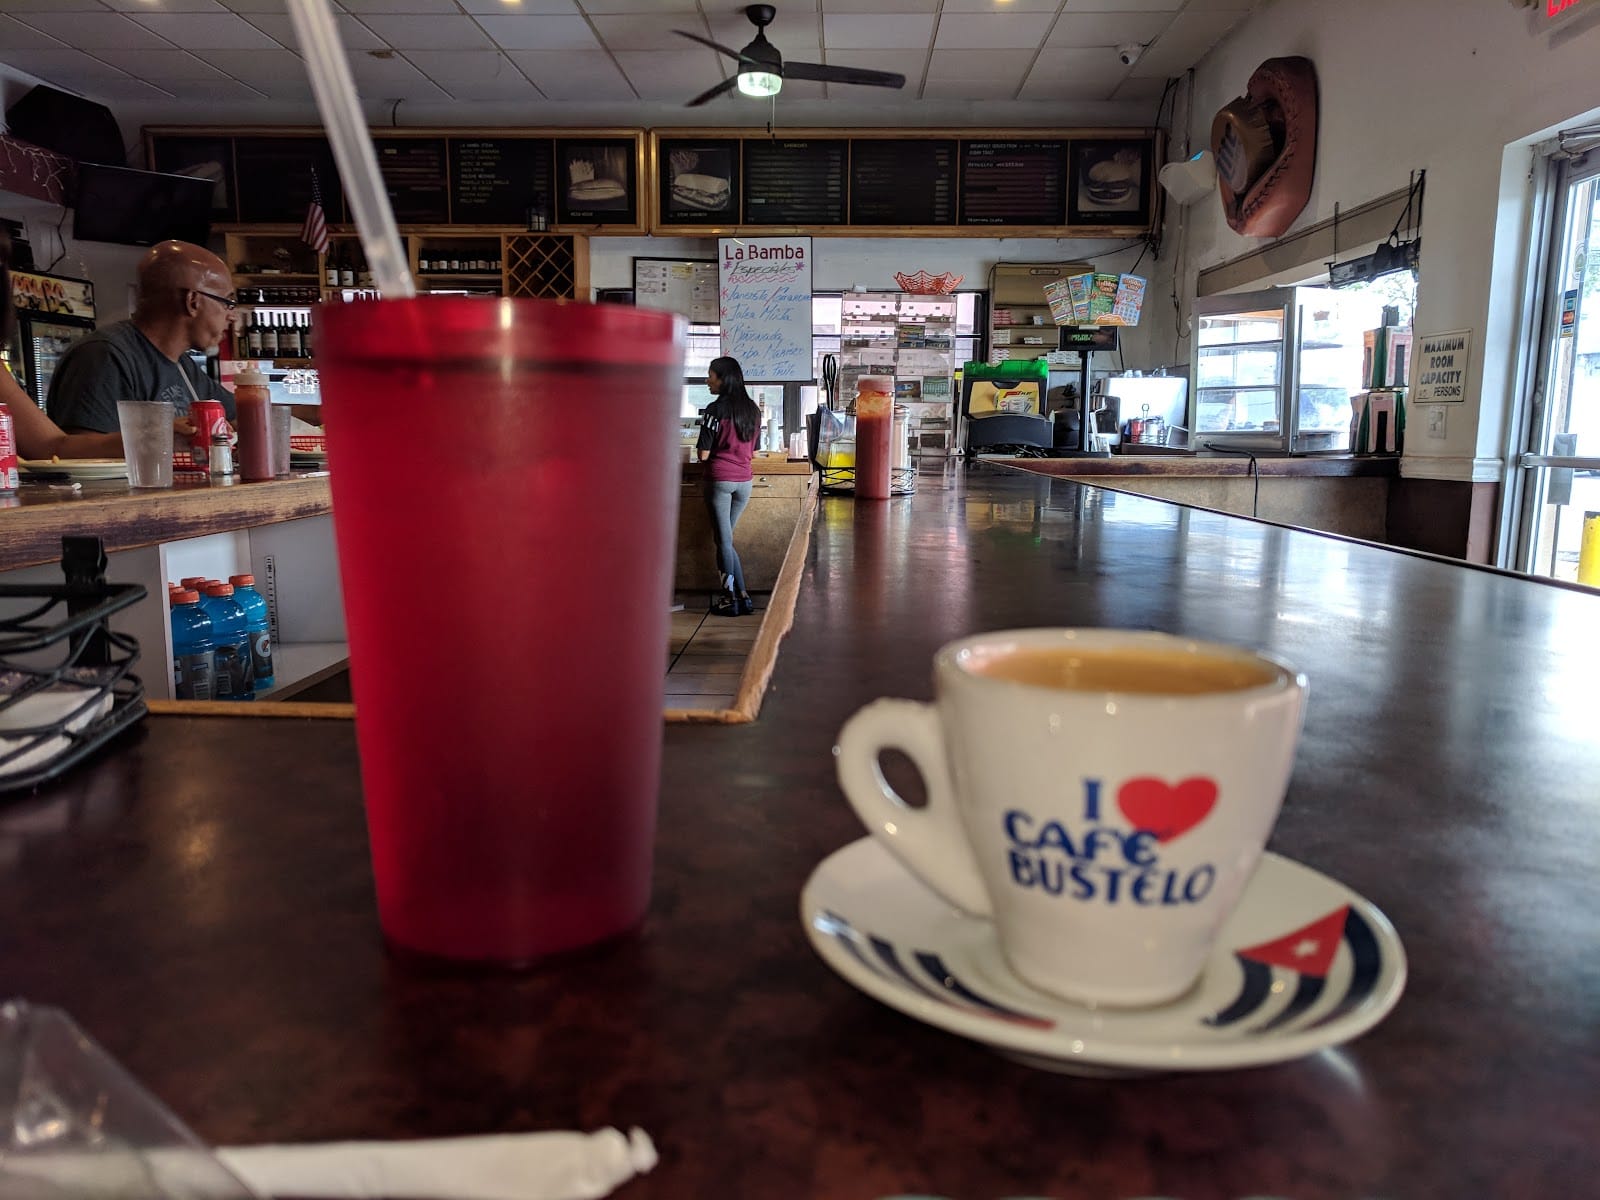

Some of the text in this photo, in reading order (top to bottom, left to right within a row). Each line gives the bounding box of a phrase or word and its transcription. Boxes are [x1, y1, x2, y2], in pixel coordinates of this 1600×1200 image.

[725, 244, 804, 260] La Bamba
[1424, 337, 1465, 353] MAXIMUM
[1430, 355, 1454, 369] ROOM
[1420, 370, 1462, 385] CAPACITY
[1433, 386, 1462, 397] PERSONS
[1082, 778, 1102, 821] I
[1008, 849, 1217, 908] BUSTELO
